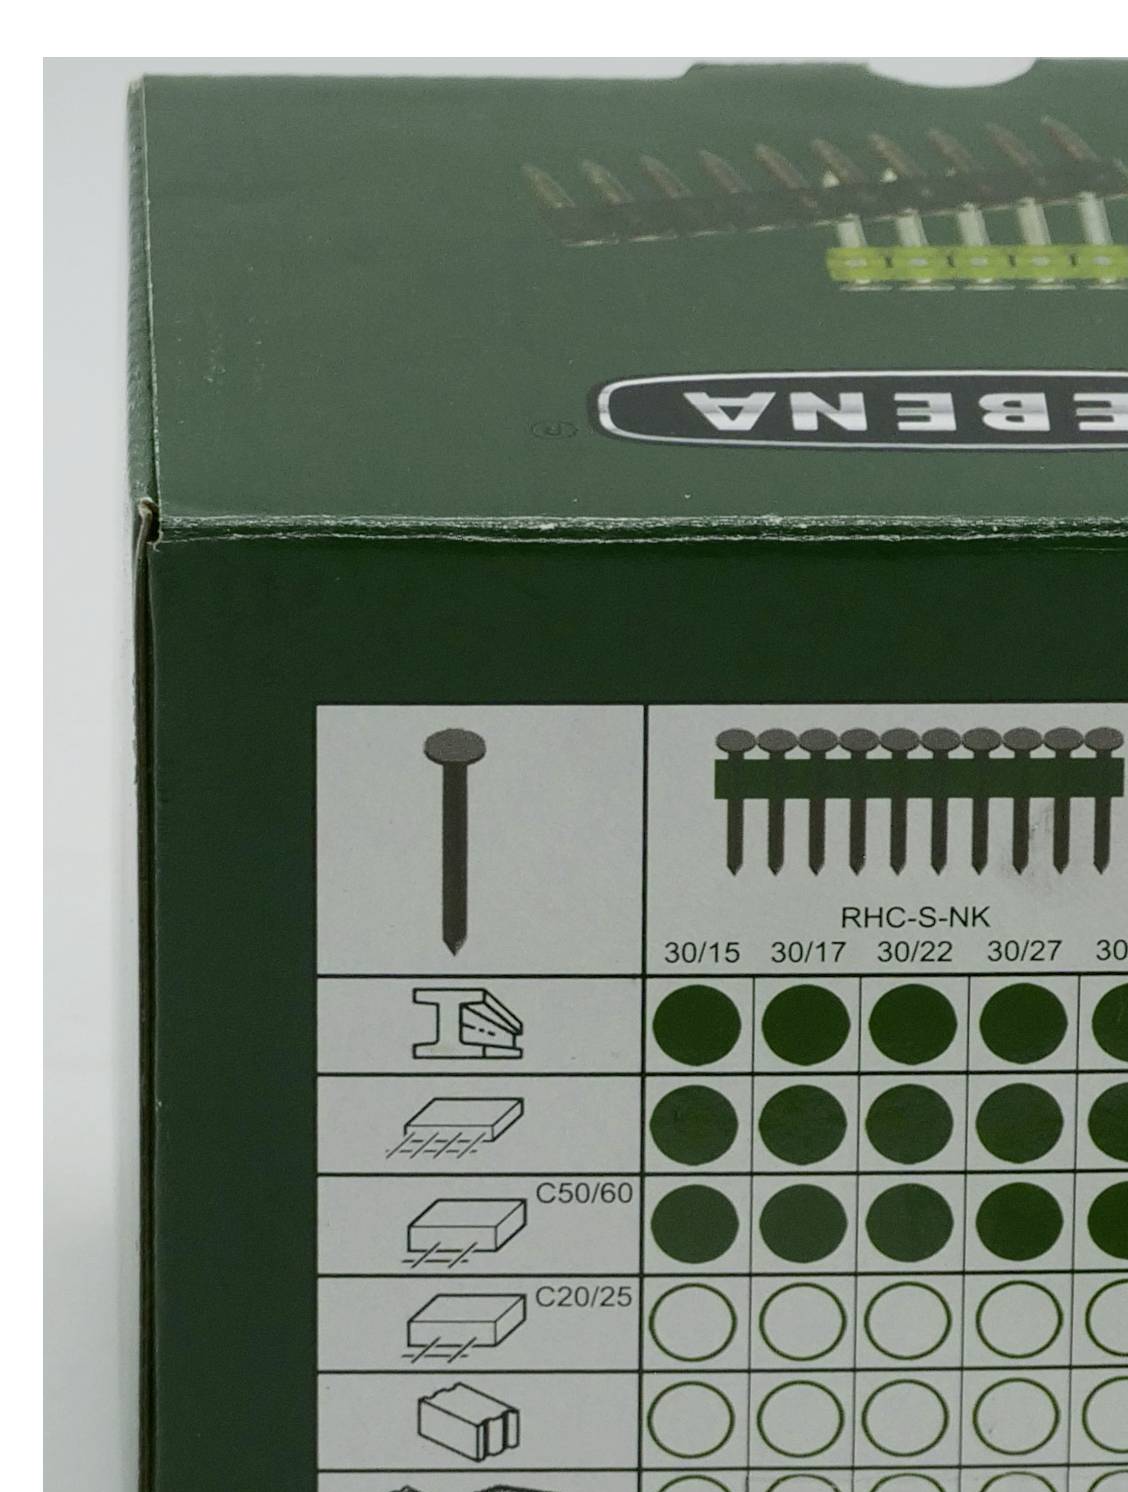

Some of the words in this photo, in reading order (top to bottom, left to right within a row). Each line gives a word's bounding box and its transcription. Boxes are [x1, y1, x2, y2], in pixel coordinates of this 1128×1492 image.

[842, 906, 991, 928] RHC-S-NK
[665, 941, 740, 963] 30/15
[771, 941, 846, 963] 30/17
[877, 940, 952, 963] 30/22
[988, 940, 1062, 962] 30/27
[536, 1182, 633, 1204] C50/60
[536, 1286, 632, 1307] C20/25
